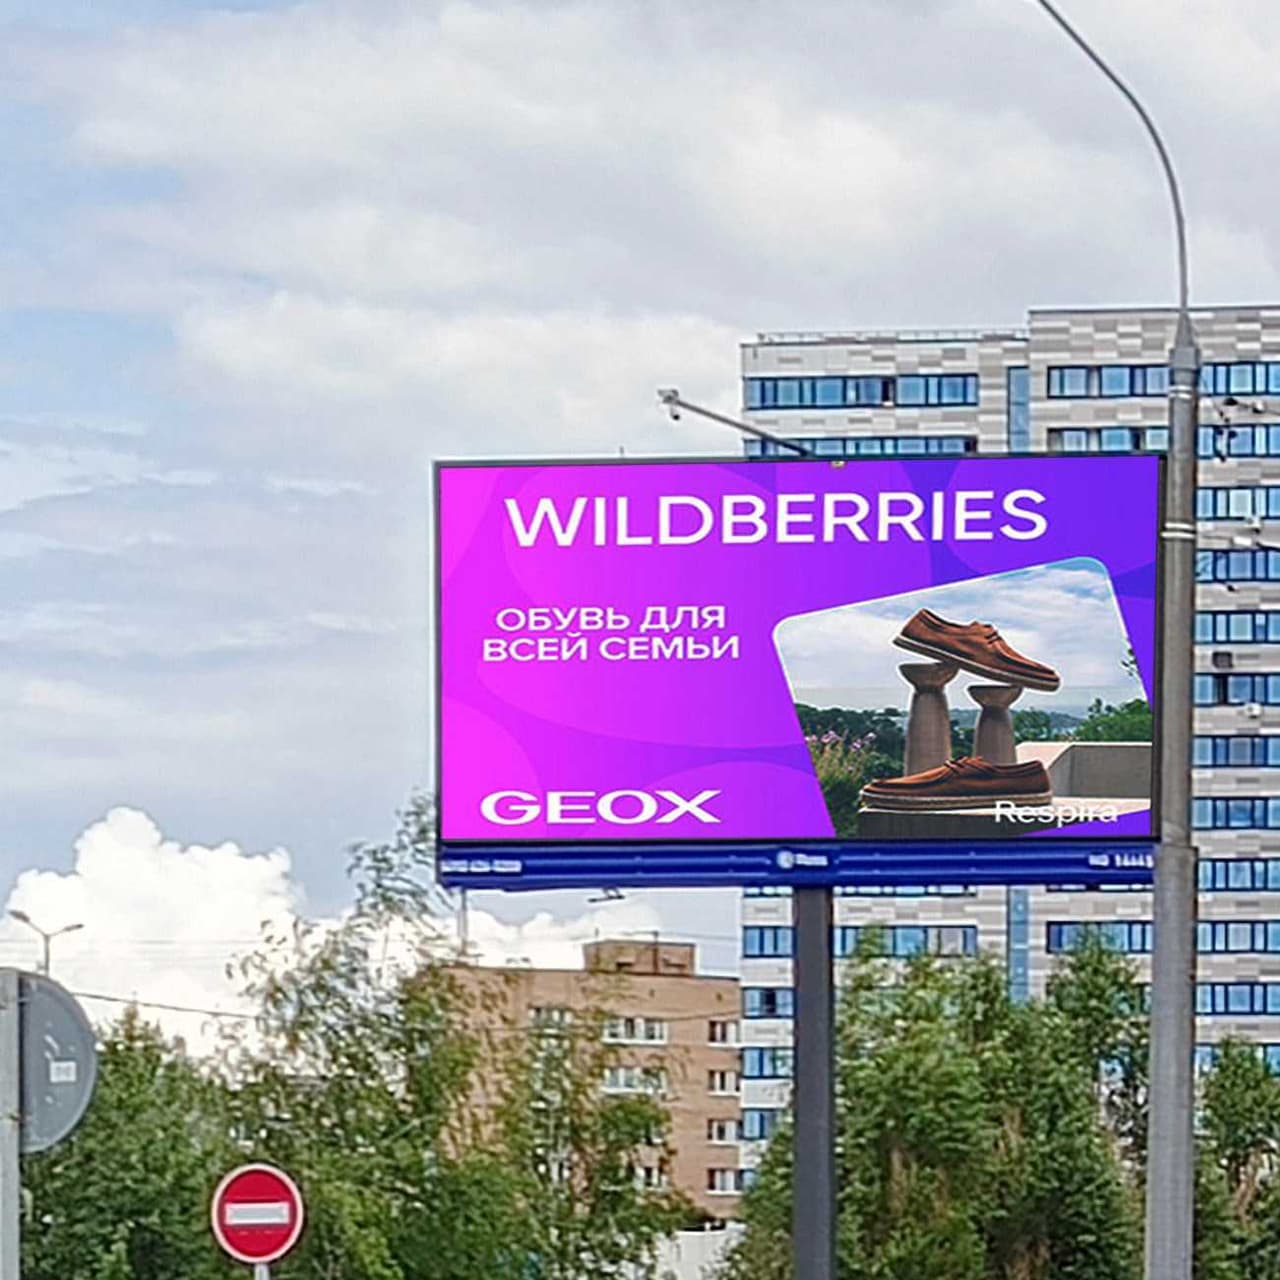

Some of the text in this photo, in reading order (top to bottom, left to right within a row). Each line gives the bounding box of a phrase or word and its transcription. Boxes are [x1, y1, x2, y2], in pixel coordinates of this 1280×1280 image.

[504, 489, 1048, 547] WILDBERRIES
[495, 605, 726, 633] ОБУВЬ ДЛЯ
[482, 631, 740, 662] ВСЕЙ СЕМЬИ
[479, 789, 722, 826] GEOX
[994, 800, 1119, 829] Respira
